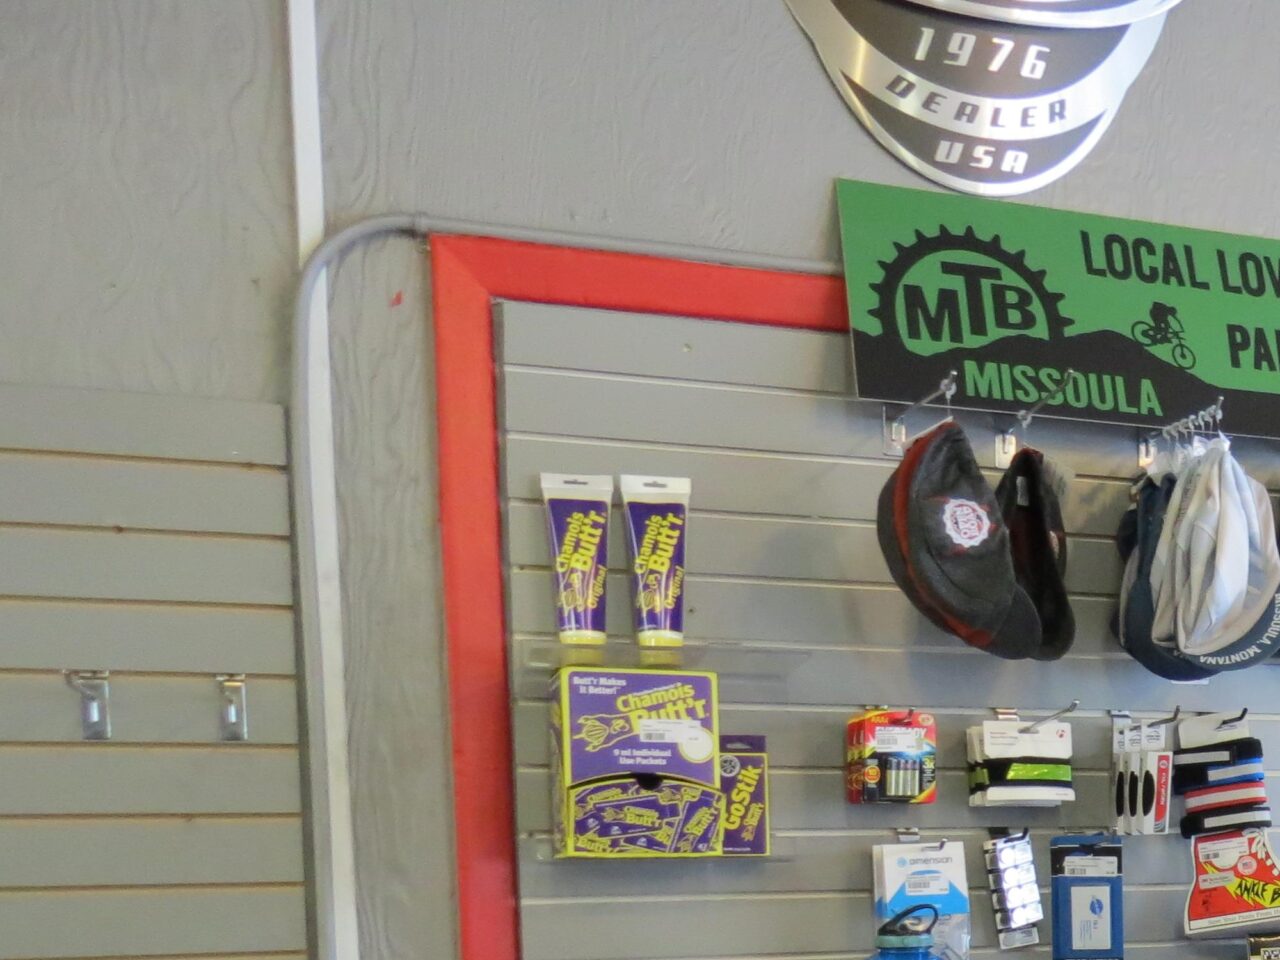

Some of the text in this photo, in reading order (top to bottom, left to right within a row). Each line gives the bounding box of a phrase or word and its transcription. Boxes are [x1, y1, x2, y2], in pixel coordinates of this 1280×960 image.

[914, 27, 1051, 80] 1976
[886, 74, 1066, 128] DEALER
[934, 140, 1029, 175] USA
[1080, 230, 1210, 291] LOCAL
[903, 261, 1037, 344] MTB
[963, 360, 1163, 417] MISSOULA
[556, 511, 585, 573] Chamois
[570, 510, 606, 572] Butt'r
[634, 514, 663, 574] Chamois
[648, 512, 684, 573] Butt'r
[1199, 645, 1262, 666] MONTANA
[615, 683, 696, 713] Chamois
[724, 764, 763, 831] GoStik
[908, 855, 953, 866] dimension
[1234, 878, 1268, 903] ANKLE
